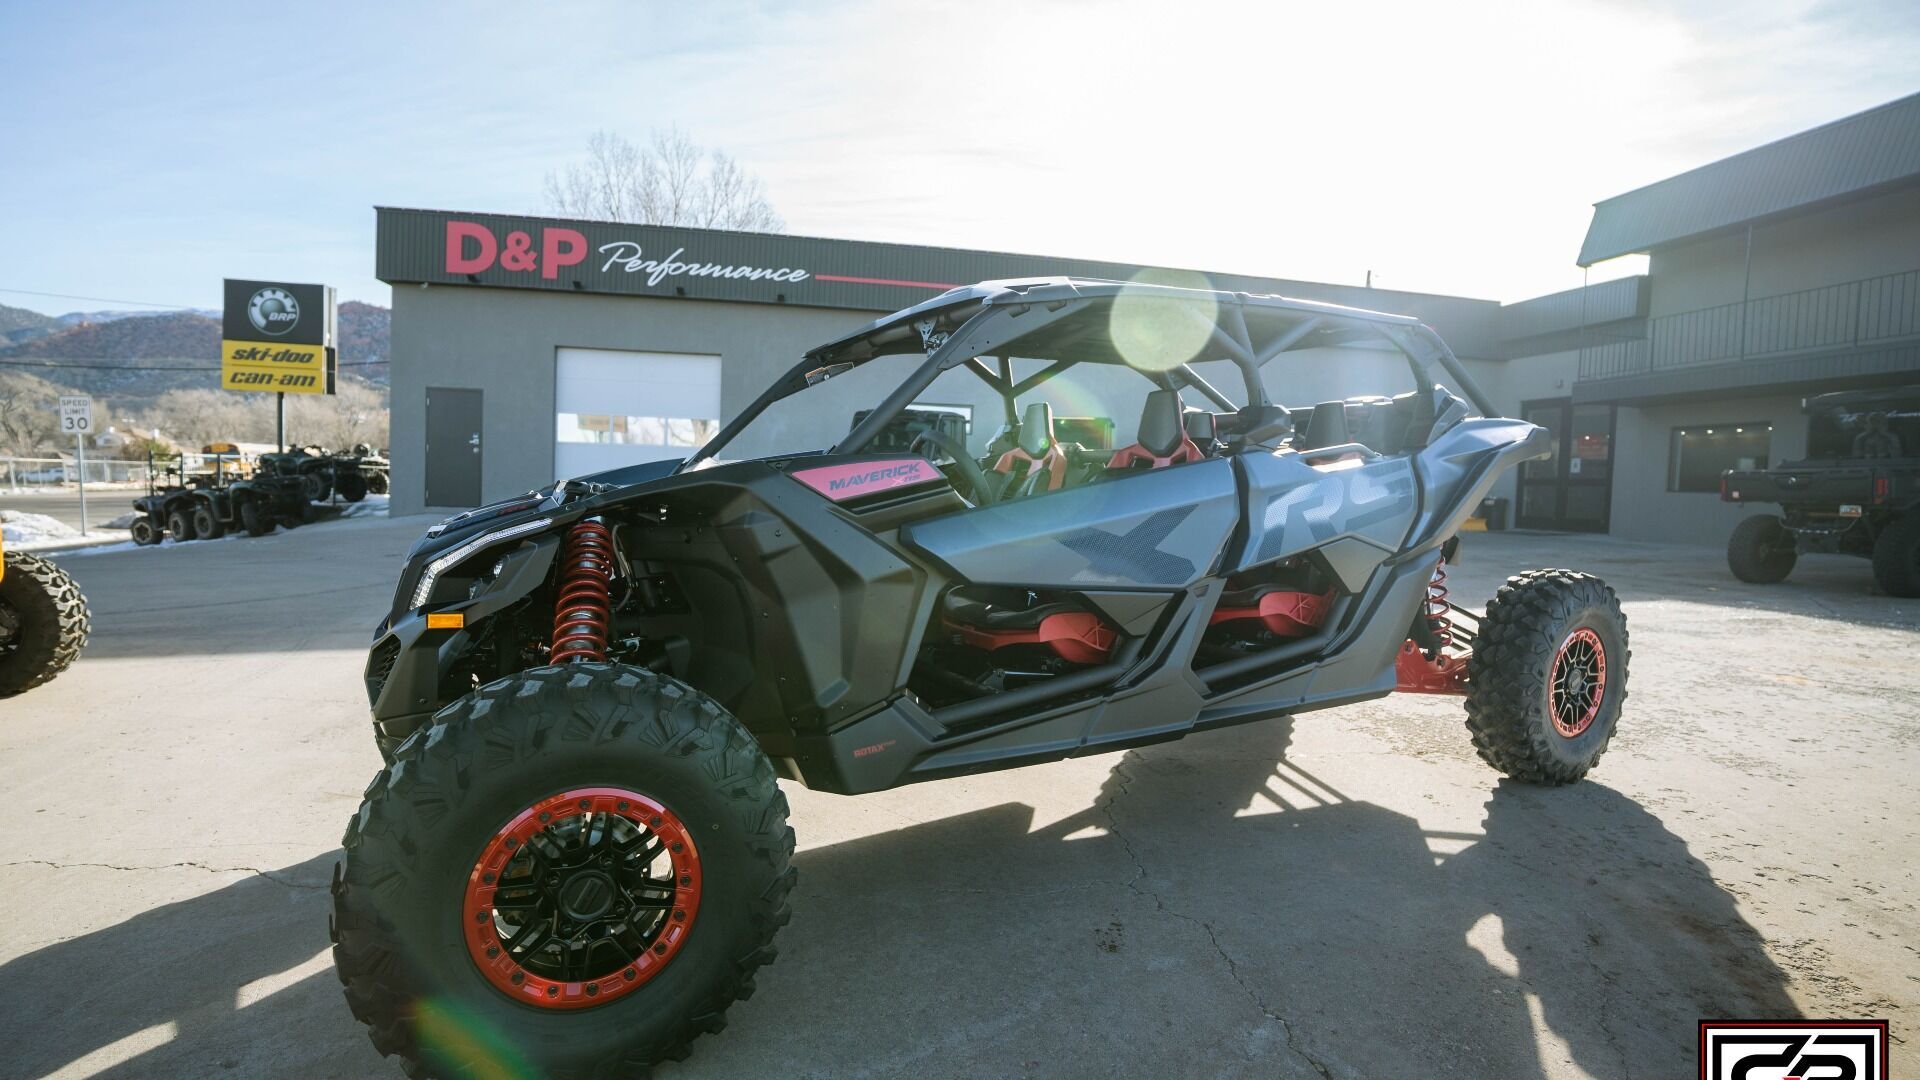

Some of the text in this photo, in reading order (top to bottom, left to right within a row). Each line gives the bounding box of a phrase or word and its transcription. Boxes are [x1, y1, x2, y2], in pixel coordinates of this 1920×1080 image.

[445, 220, 811, 287] D&P Performance
[268, 312, 297, 322] BRP
[231, 347, 315, 364] ski-doo
[229, 371, 317, 388] can-am
[61, 399, 88, 407] SPEED
[64, 408, 86, 416] LIMIT
[65, 417, 88, 430] 30
[829, 462, 921, 492] MAVERICK
